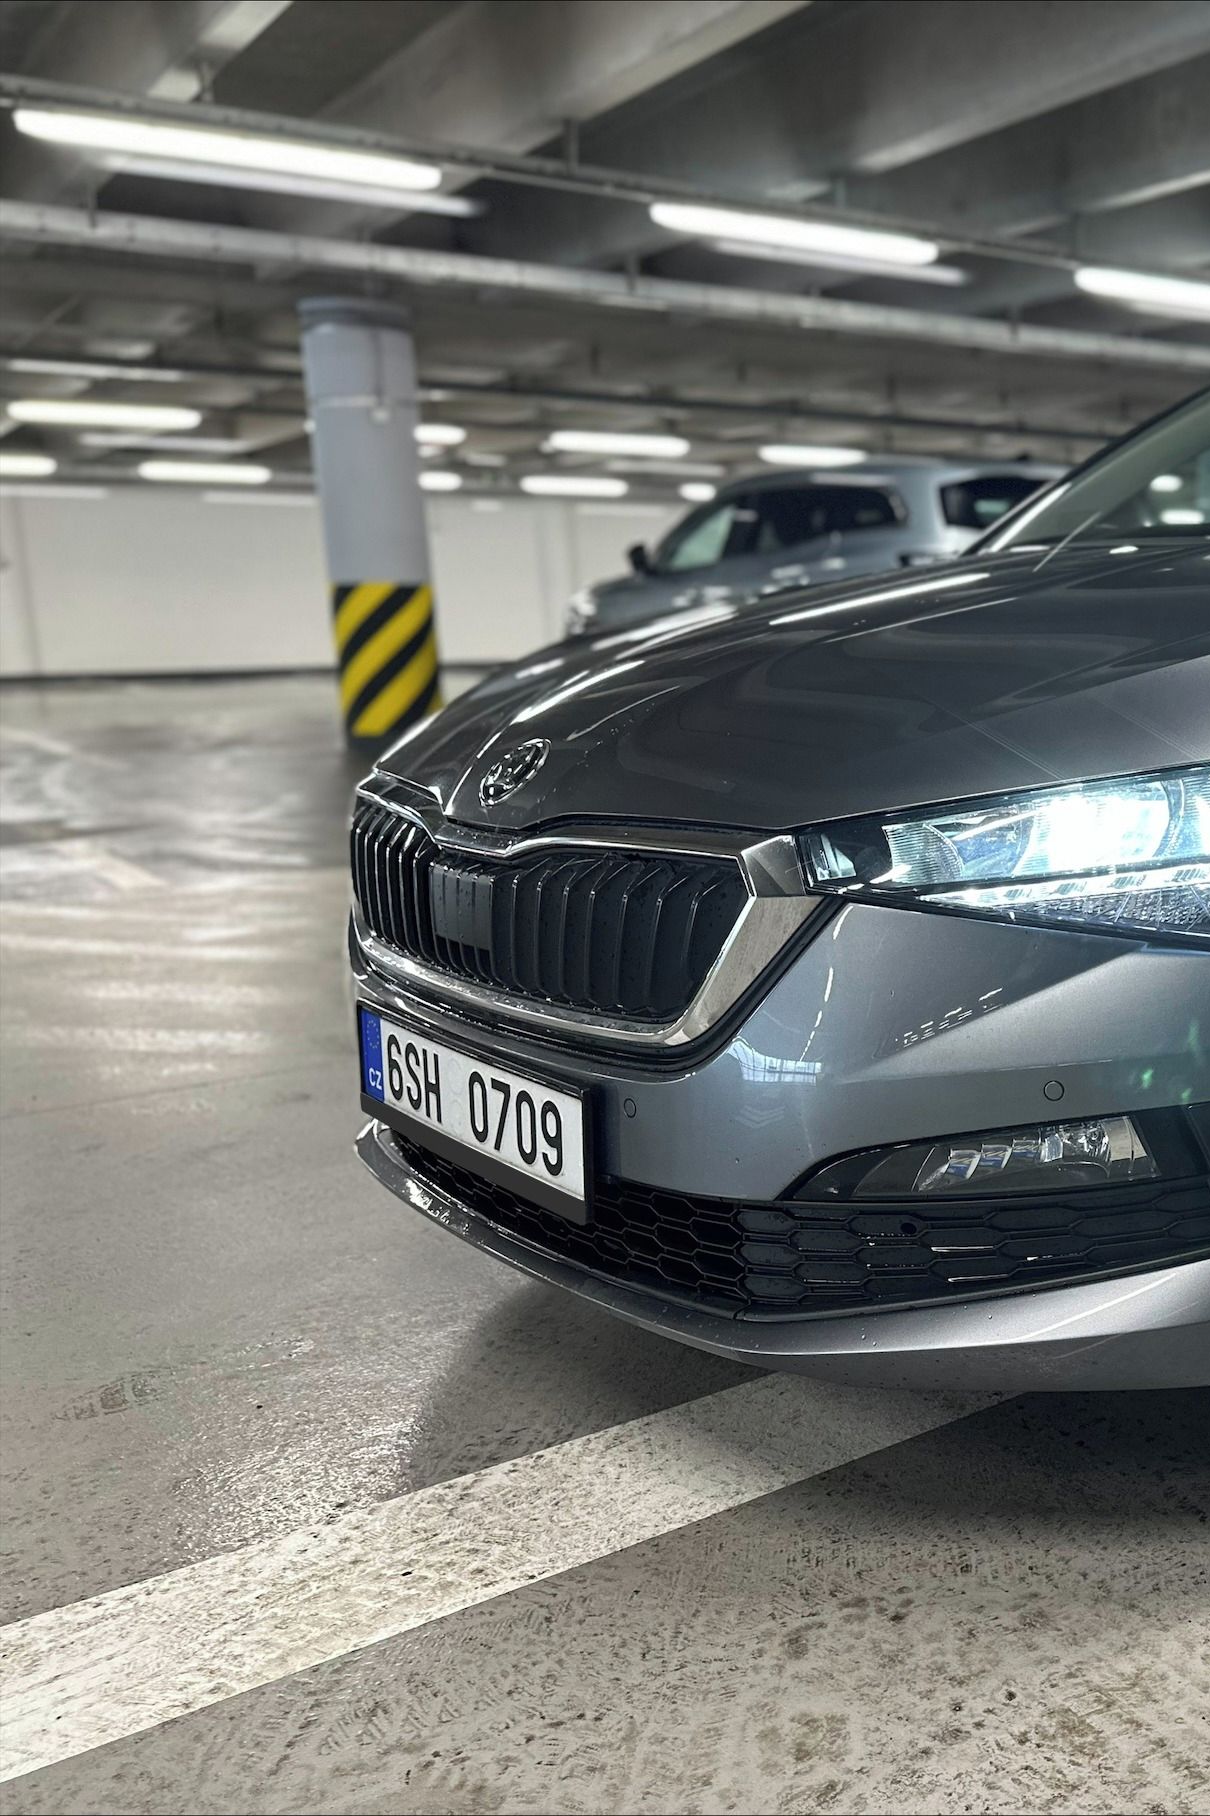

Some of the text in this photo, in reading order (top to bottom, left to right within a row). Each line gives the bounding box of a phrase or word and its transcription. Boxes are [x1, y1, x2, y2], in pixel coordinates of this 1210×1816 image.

[368, 1067, 383, 1091] CZ
[387, 1033, 564, 1177] 6SH 0709
